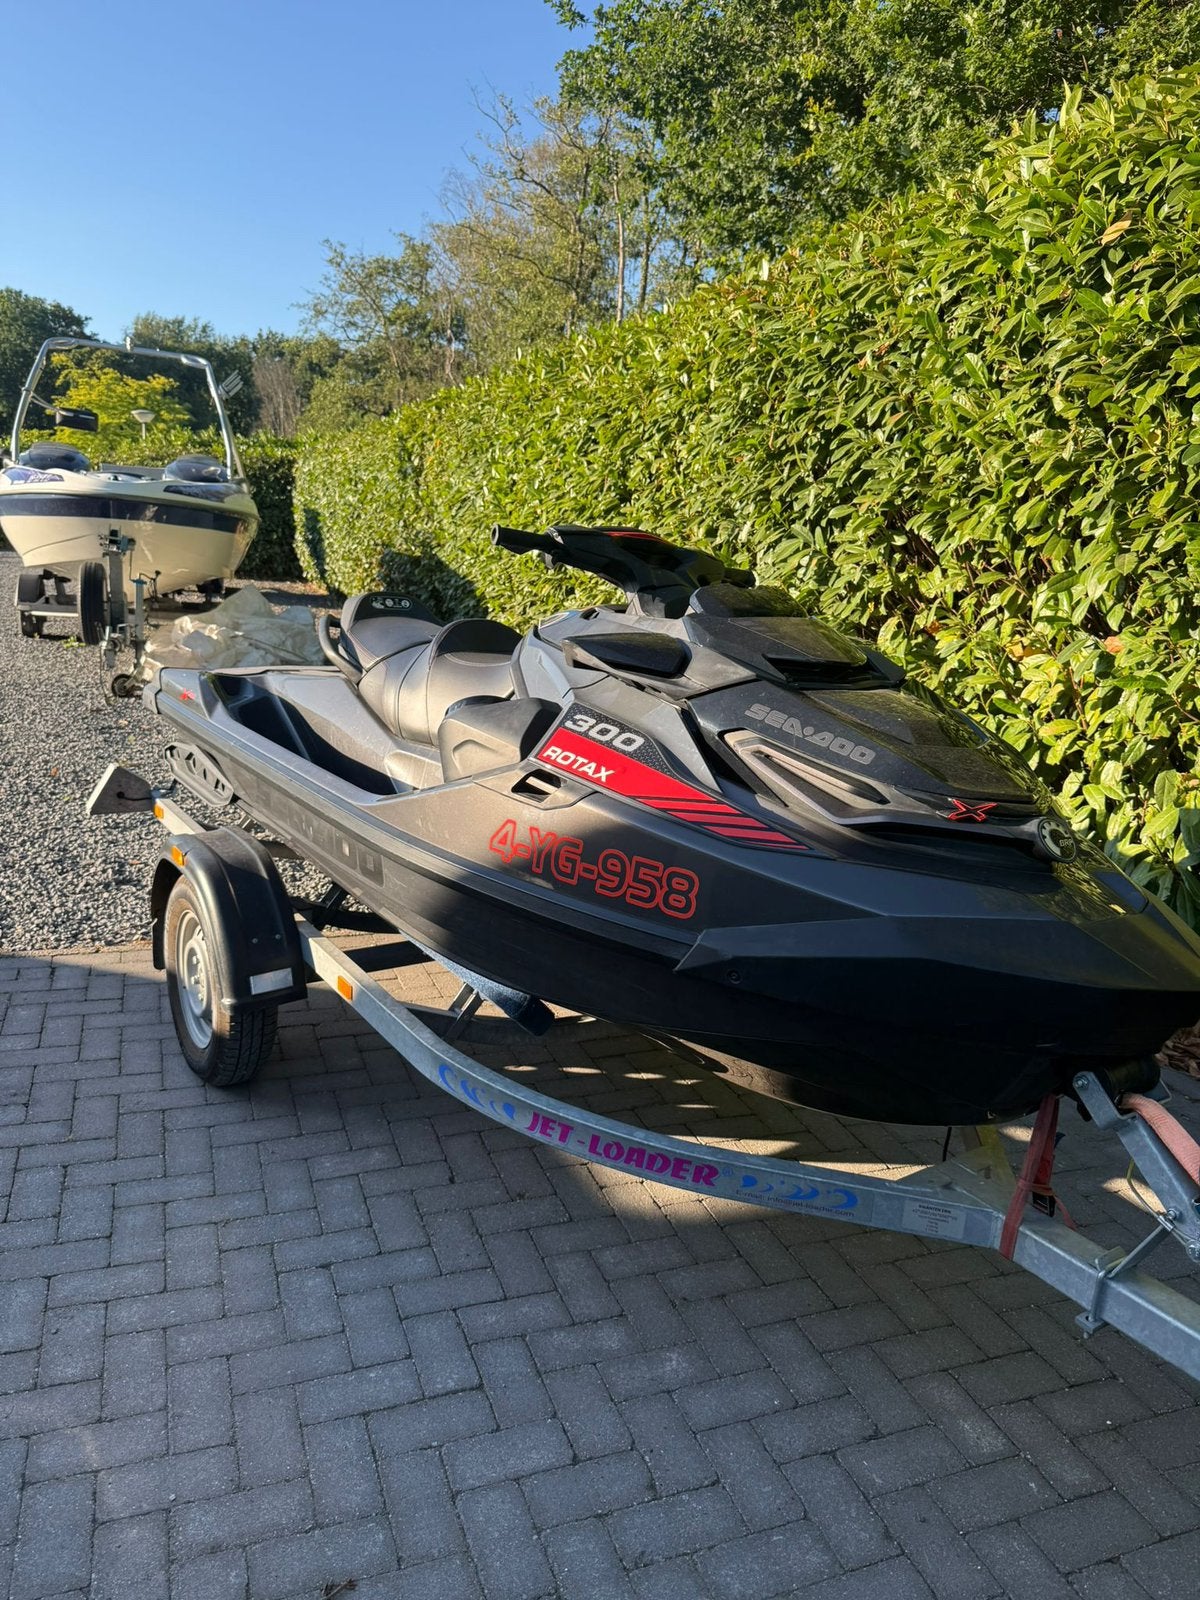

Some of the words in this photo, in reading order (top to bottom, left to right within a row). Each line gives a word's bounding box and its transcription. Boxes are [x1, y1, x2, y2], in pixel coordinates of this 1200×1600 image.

[564, 713, 645, 752] 300
[543, 745, 615, 783] ROTAX
[489, 818, 700, 920] 4-YG-958
